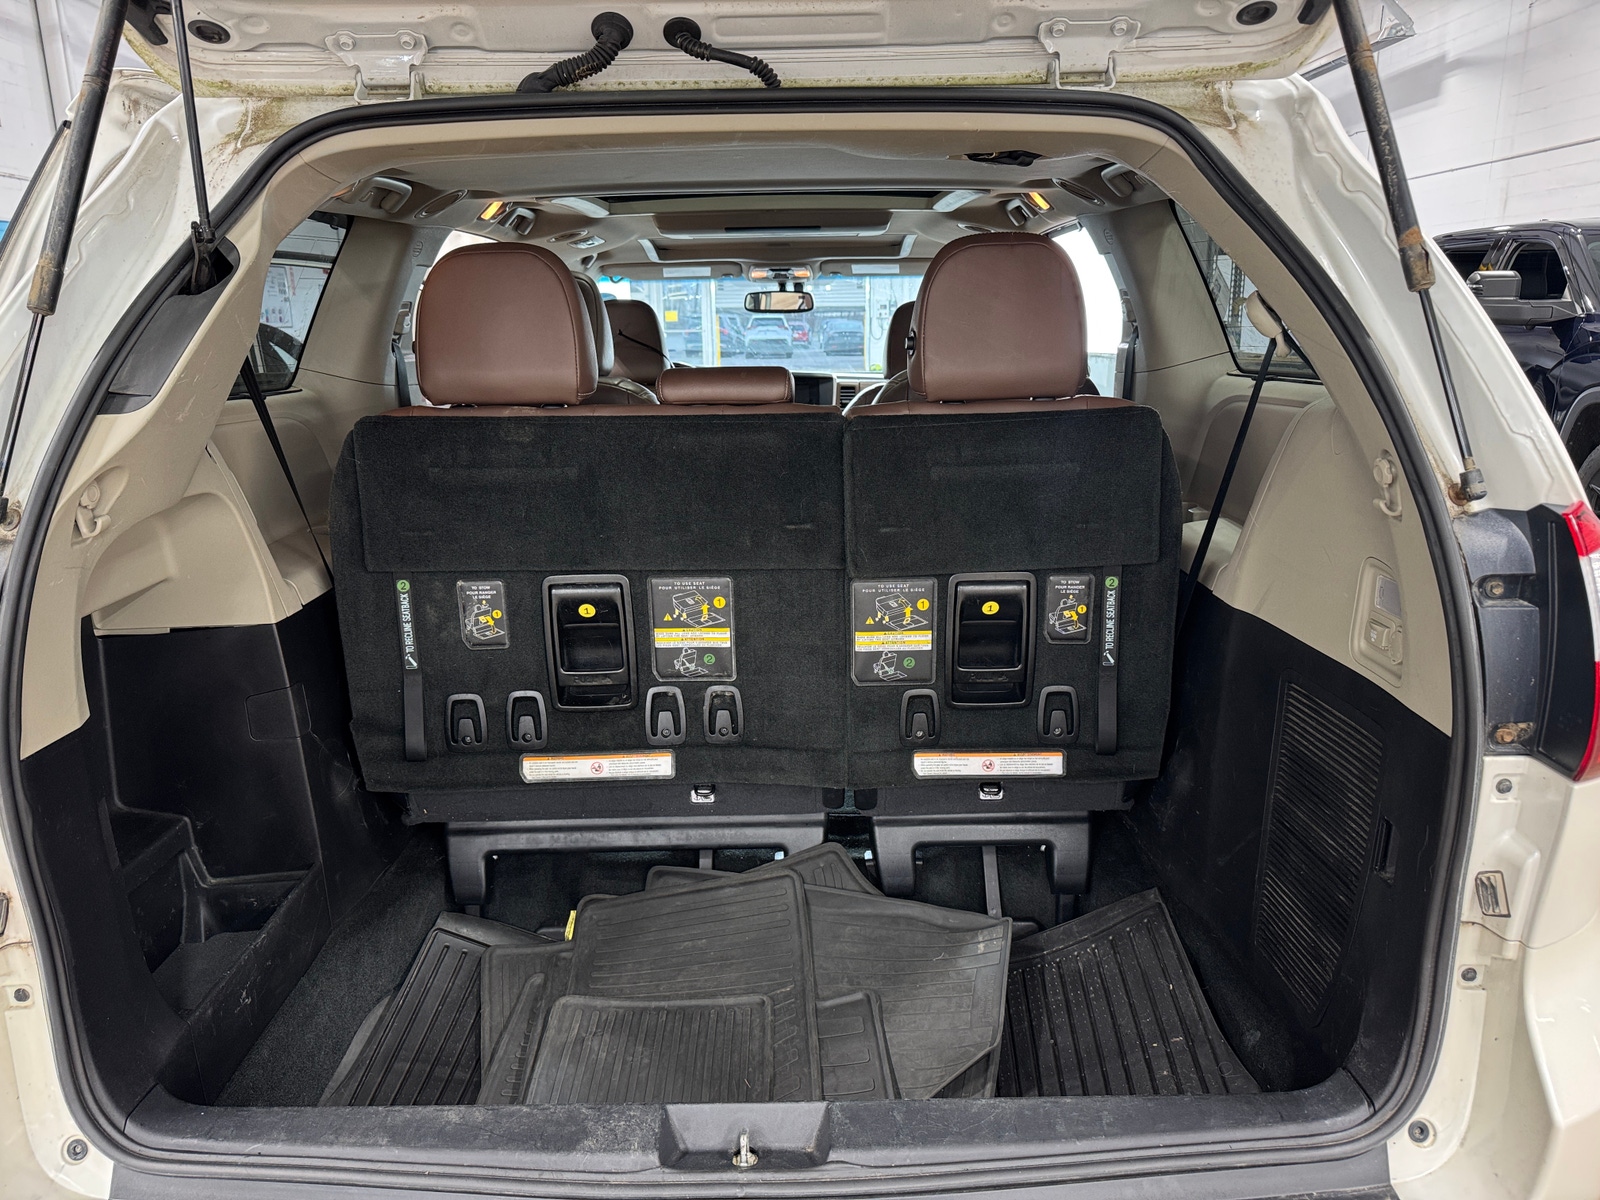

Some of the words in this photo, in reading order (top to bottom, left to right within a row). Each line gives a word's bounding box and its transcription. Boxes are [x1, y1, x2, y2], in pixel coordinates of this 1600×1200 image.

[400, 593, 411, 622] SEATBACK
[1106, 590, 1116, 619] SEATBACK
[403, 622, 414, 645] RECLINE
[1105, 619, 1114, 642] RECLINE
[405, 645, 415, 654] TO
[1105, 642, 1114, 650] TO
